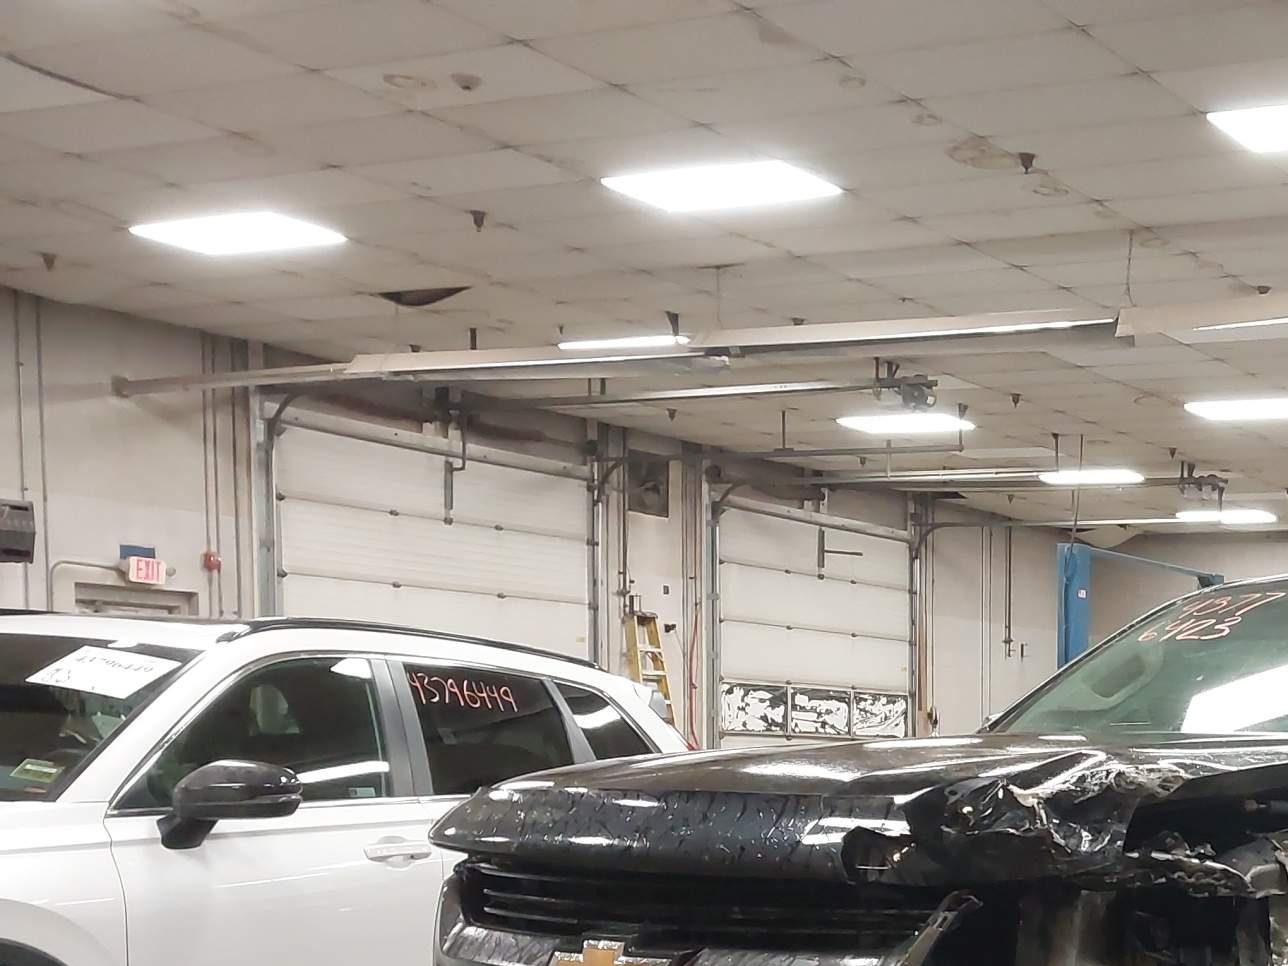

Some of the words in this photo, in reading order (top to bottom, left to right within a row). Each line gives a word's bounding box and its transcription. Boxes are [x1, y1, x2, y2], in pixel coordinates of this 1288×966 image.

[136, 559, 161, 582] EXIT
[1179, 592, 1287, 618] 4377
[1137, 615, 1243, 642] 6423
[406, 671, 518, 713] 43796449
